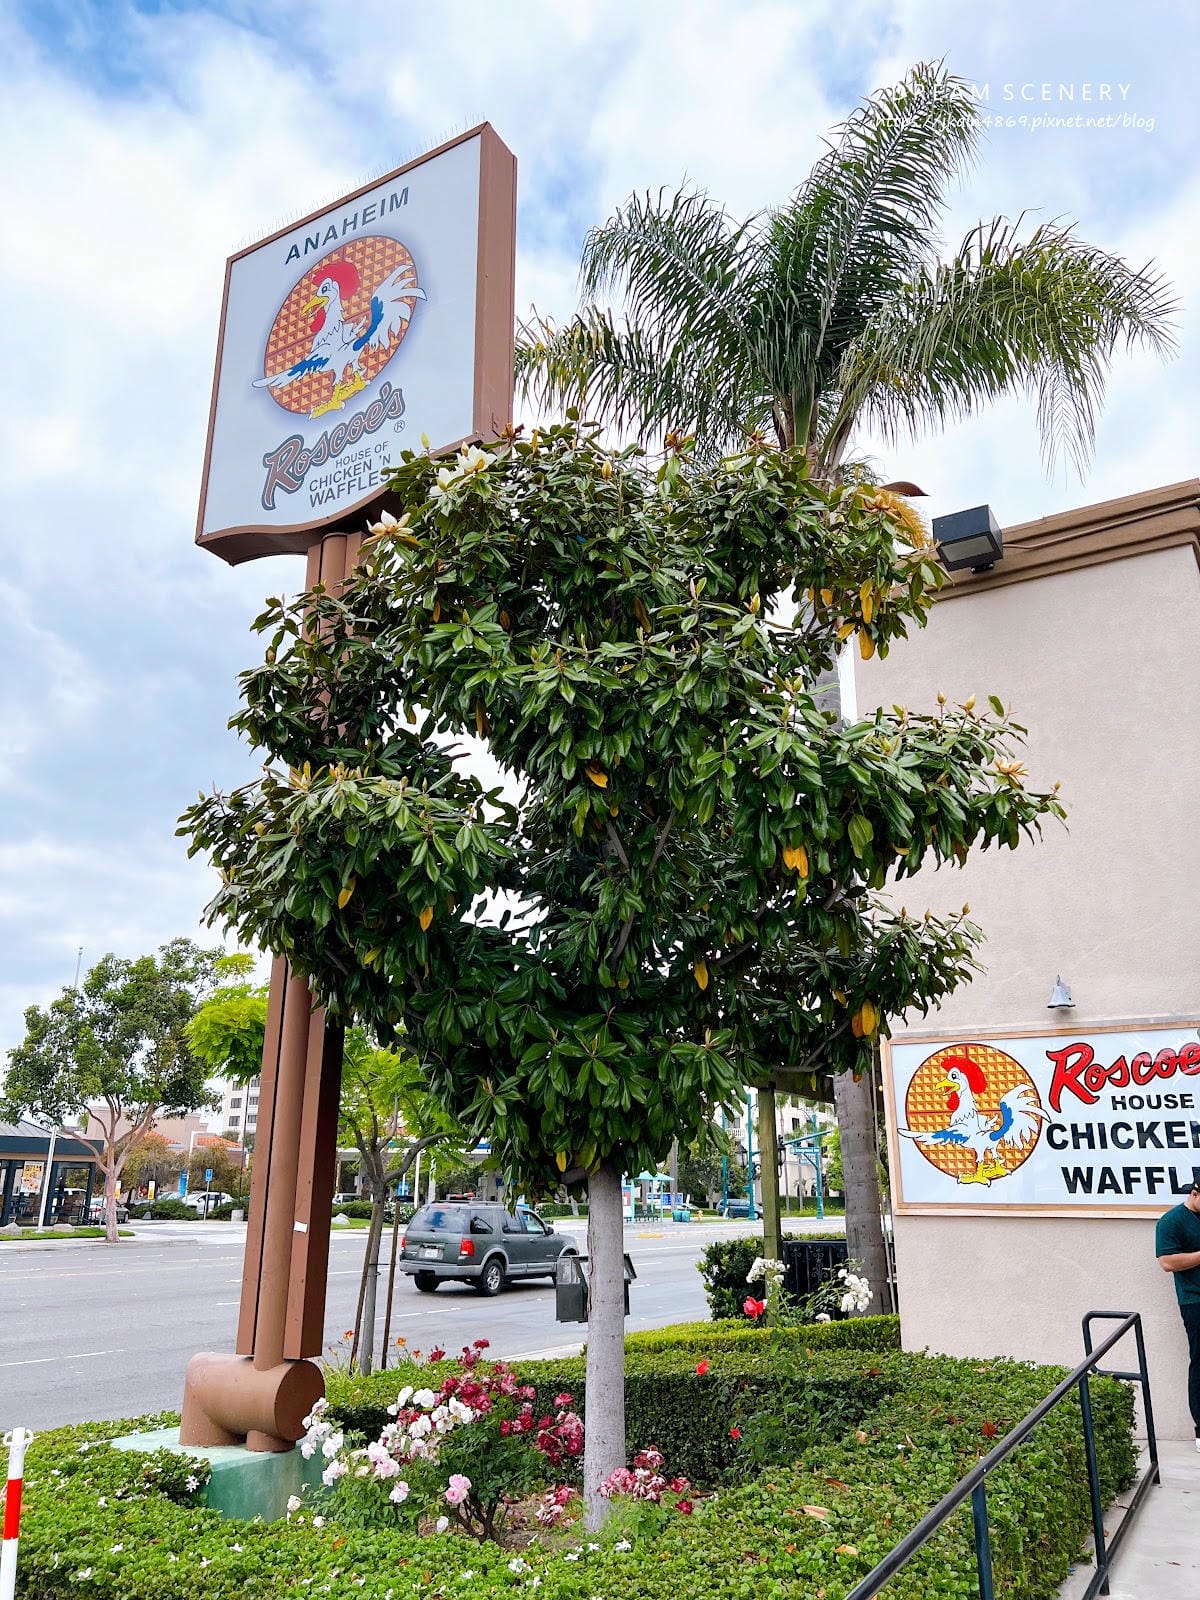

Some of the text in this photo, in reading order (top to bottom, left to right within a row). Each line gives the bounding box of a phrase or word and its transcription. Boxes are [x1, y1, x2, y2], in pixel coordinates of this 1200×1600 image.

[285, 187, 409, 264] ANAHEIM
[262, 381, 406, 510] Roscoe's
[335, 441, 389, 469] HOUSE OF
[309, 453, 391, 492] CHICKEN 'N
[1112, 1093, 1195, 1111] HOUSE
[1061, 1166, 1200, 1195] WAFFL
